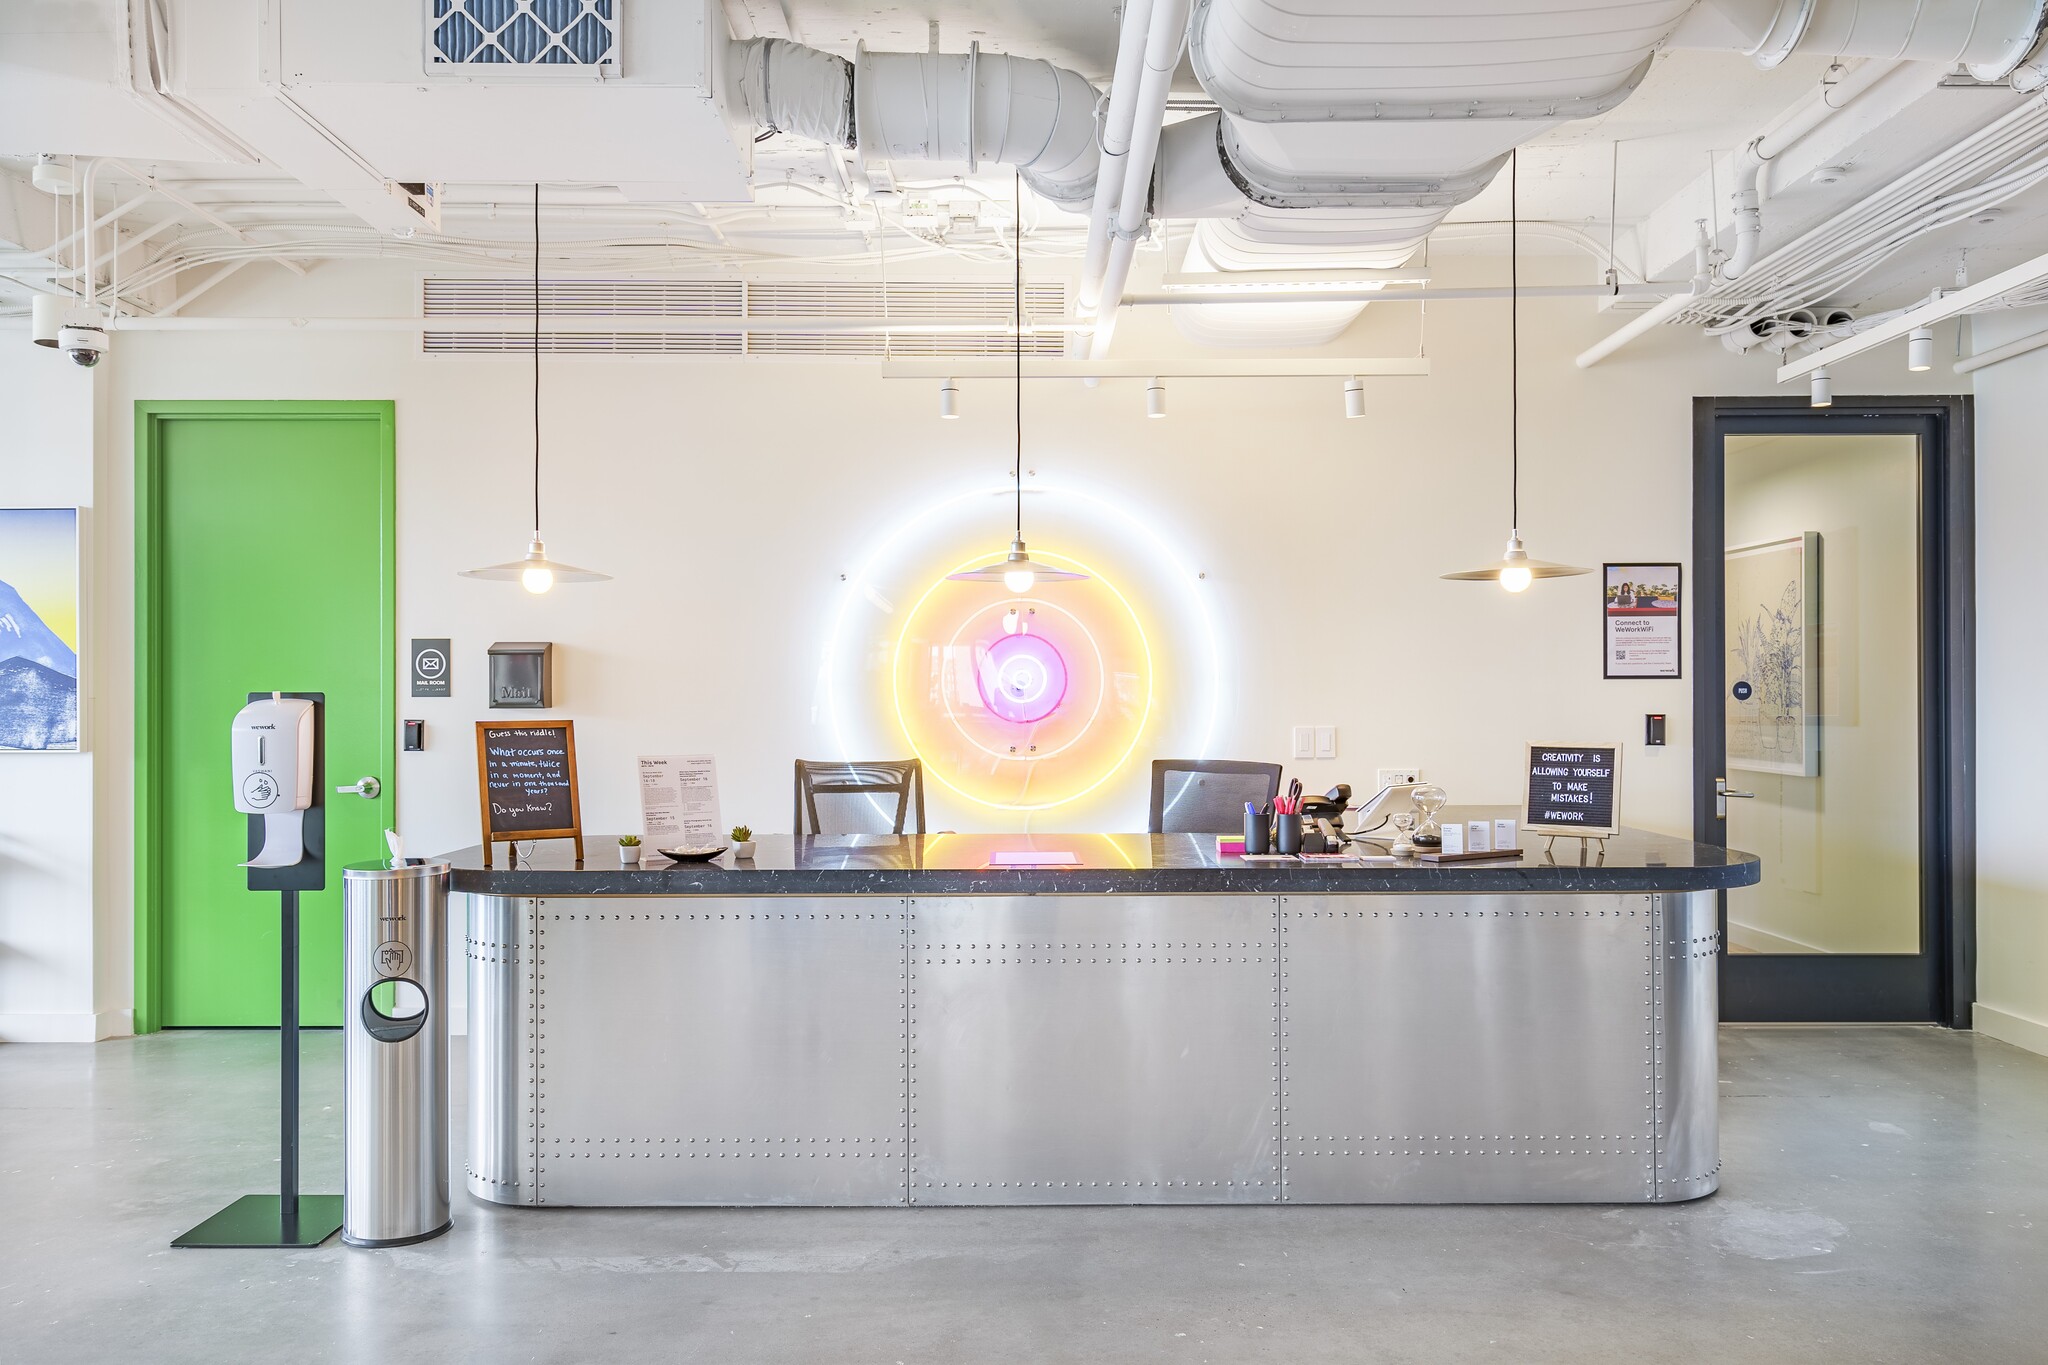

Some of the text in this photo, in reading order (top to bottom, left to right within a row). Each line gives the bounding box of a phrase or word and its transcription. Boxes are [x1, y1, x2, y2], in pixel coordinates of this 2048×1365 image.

[501, 686, 534, 699] Mail
[530, 729, 556, 738] riddle!
[490, 747, 516, 757] What
[1542, 753, 1601, 762] CREATIVITY IS
[1532, 767, 1610, 777] ALLOWING YOURSELF
[1552, 782, 1588, 791] TO MAKE
[525, 788, 548, 796] years?
[1551, 792, 1593, 804] MISTAKES!
[492, 802, 552, 817] Do you Know?
[1544, 811, 1584, 821] #WEWORK
